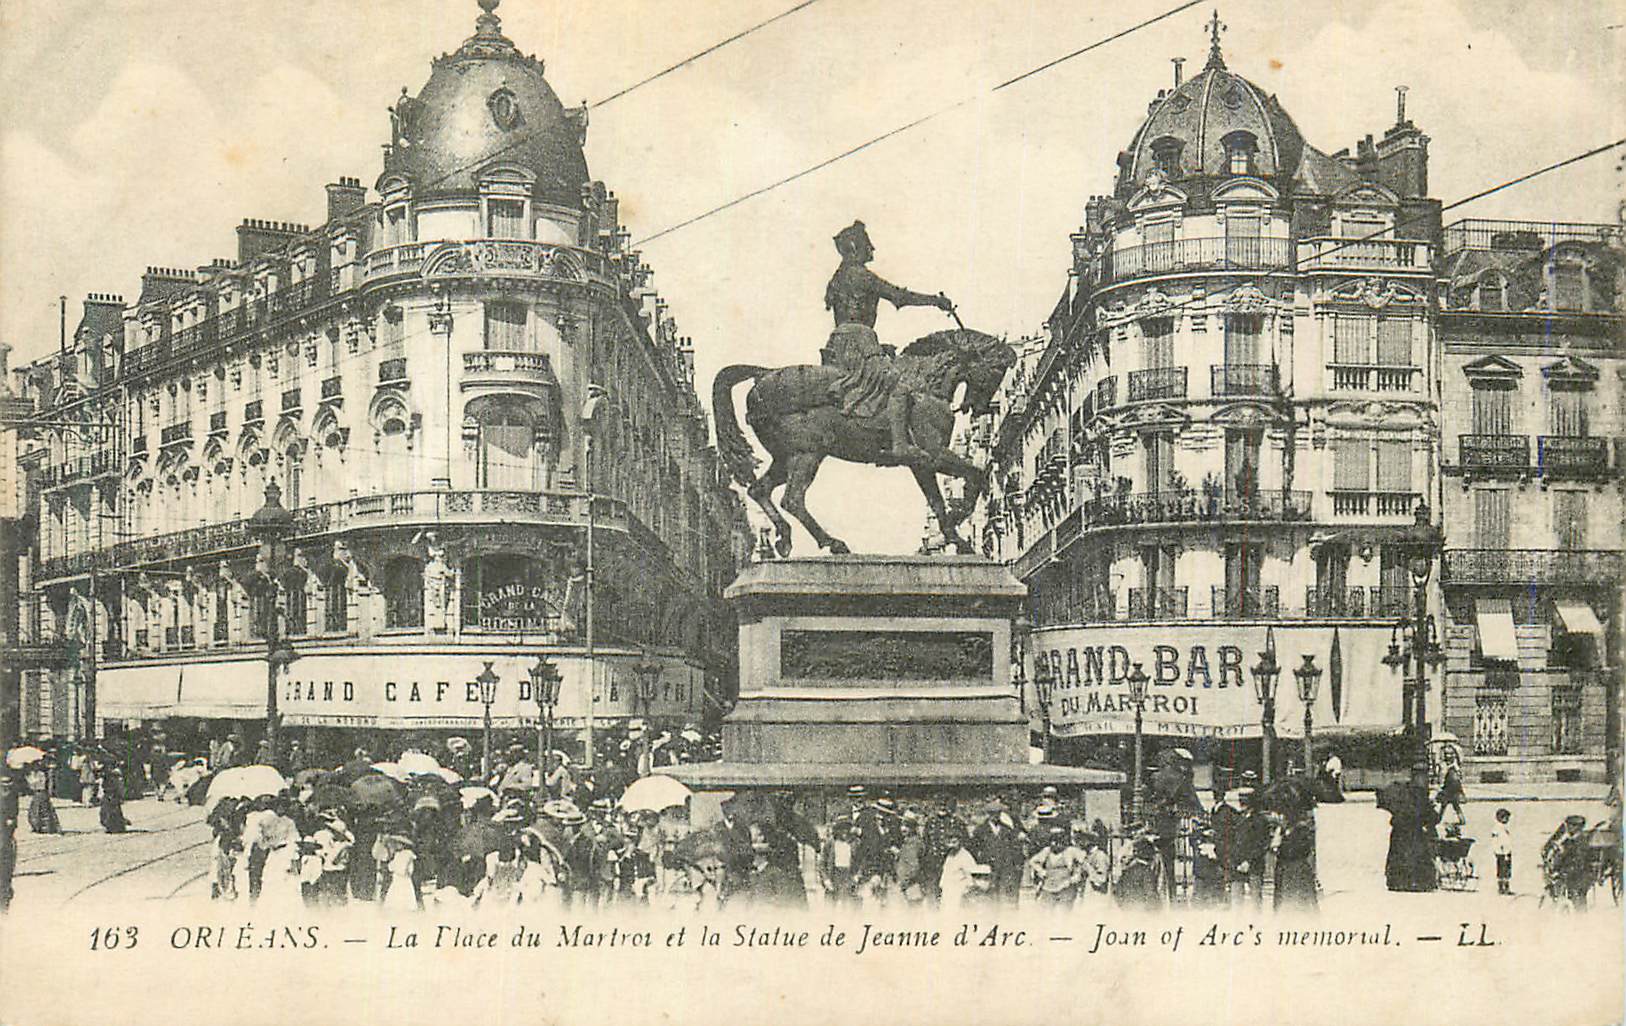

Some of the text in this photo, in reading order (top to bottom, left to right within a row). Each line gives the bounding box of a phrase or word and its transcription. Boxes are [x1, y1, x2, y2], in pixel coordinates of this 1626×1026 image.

[1153, 644, 1245, 689] BAR
[385, 682, 479, 702] CAFE
[1061, 691, 1200, 716] DU MARTROI
